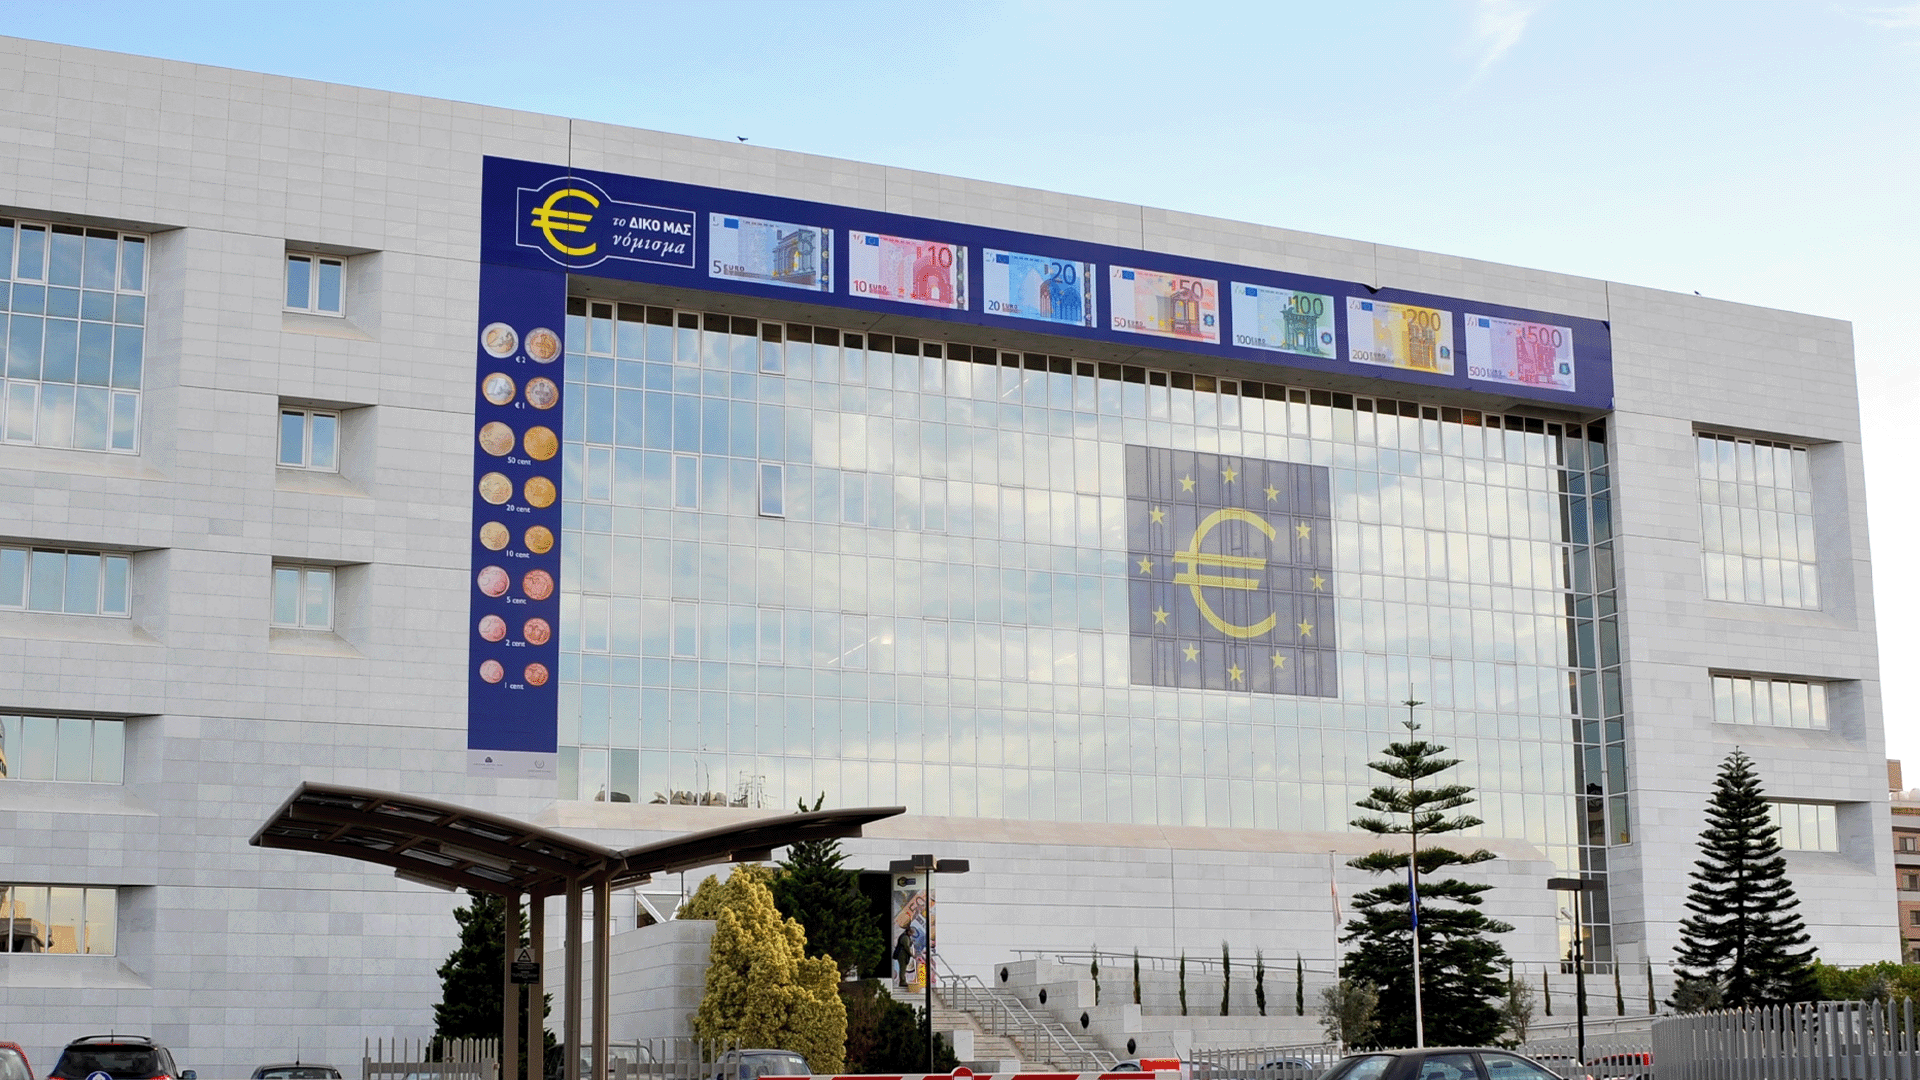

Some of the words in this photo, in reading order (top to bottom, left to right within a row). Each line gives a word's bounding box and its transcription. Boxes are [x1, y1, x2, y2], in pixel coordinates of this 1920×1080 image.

[612, 217, 626, 227] το
[629, 216, 661, 232] ΔΙΚΟ
[663, 220, 691, 236] ΜΑΣ
[612, 232, 686, 257] νόμισμα
[928, 245, 953, 268] 10
[713, 260, 722, 274] 5
[1051, 262, 1076, 285] 20
[853, 280, 867, 292] 10
[1180, 279, 1204, 300] 50
[988, 300, 1000, 311] 20
[1292, 295, 1324, 316] 100
[1114, 317, 1126, 328] 50
[1406, 309, 1441, 331] 200
[1236, 334, 1251, 345] 100
[1528, 326, 1562, 348] 500
[1352, 349, 1369, 360] 200
[1469, 366, 1486, 377] 500
[516, 506, 530, 514] cent
[506, 639, 510, 647] 2
[512, 640, 526, 648] cent
